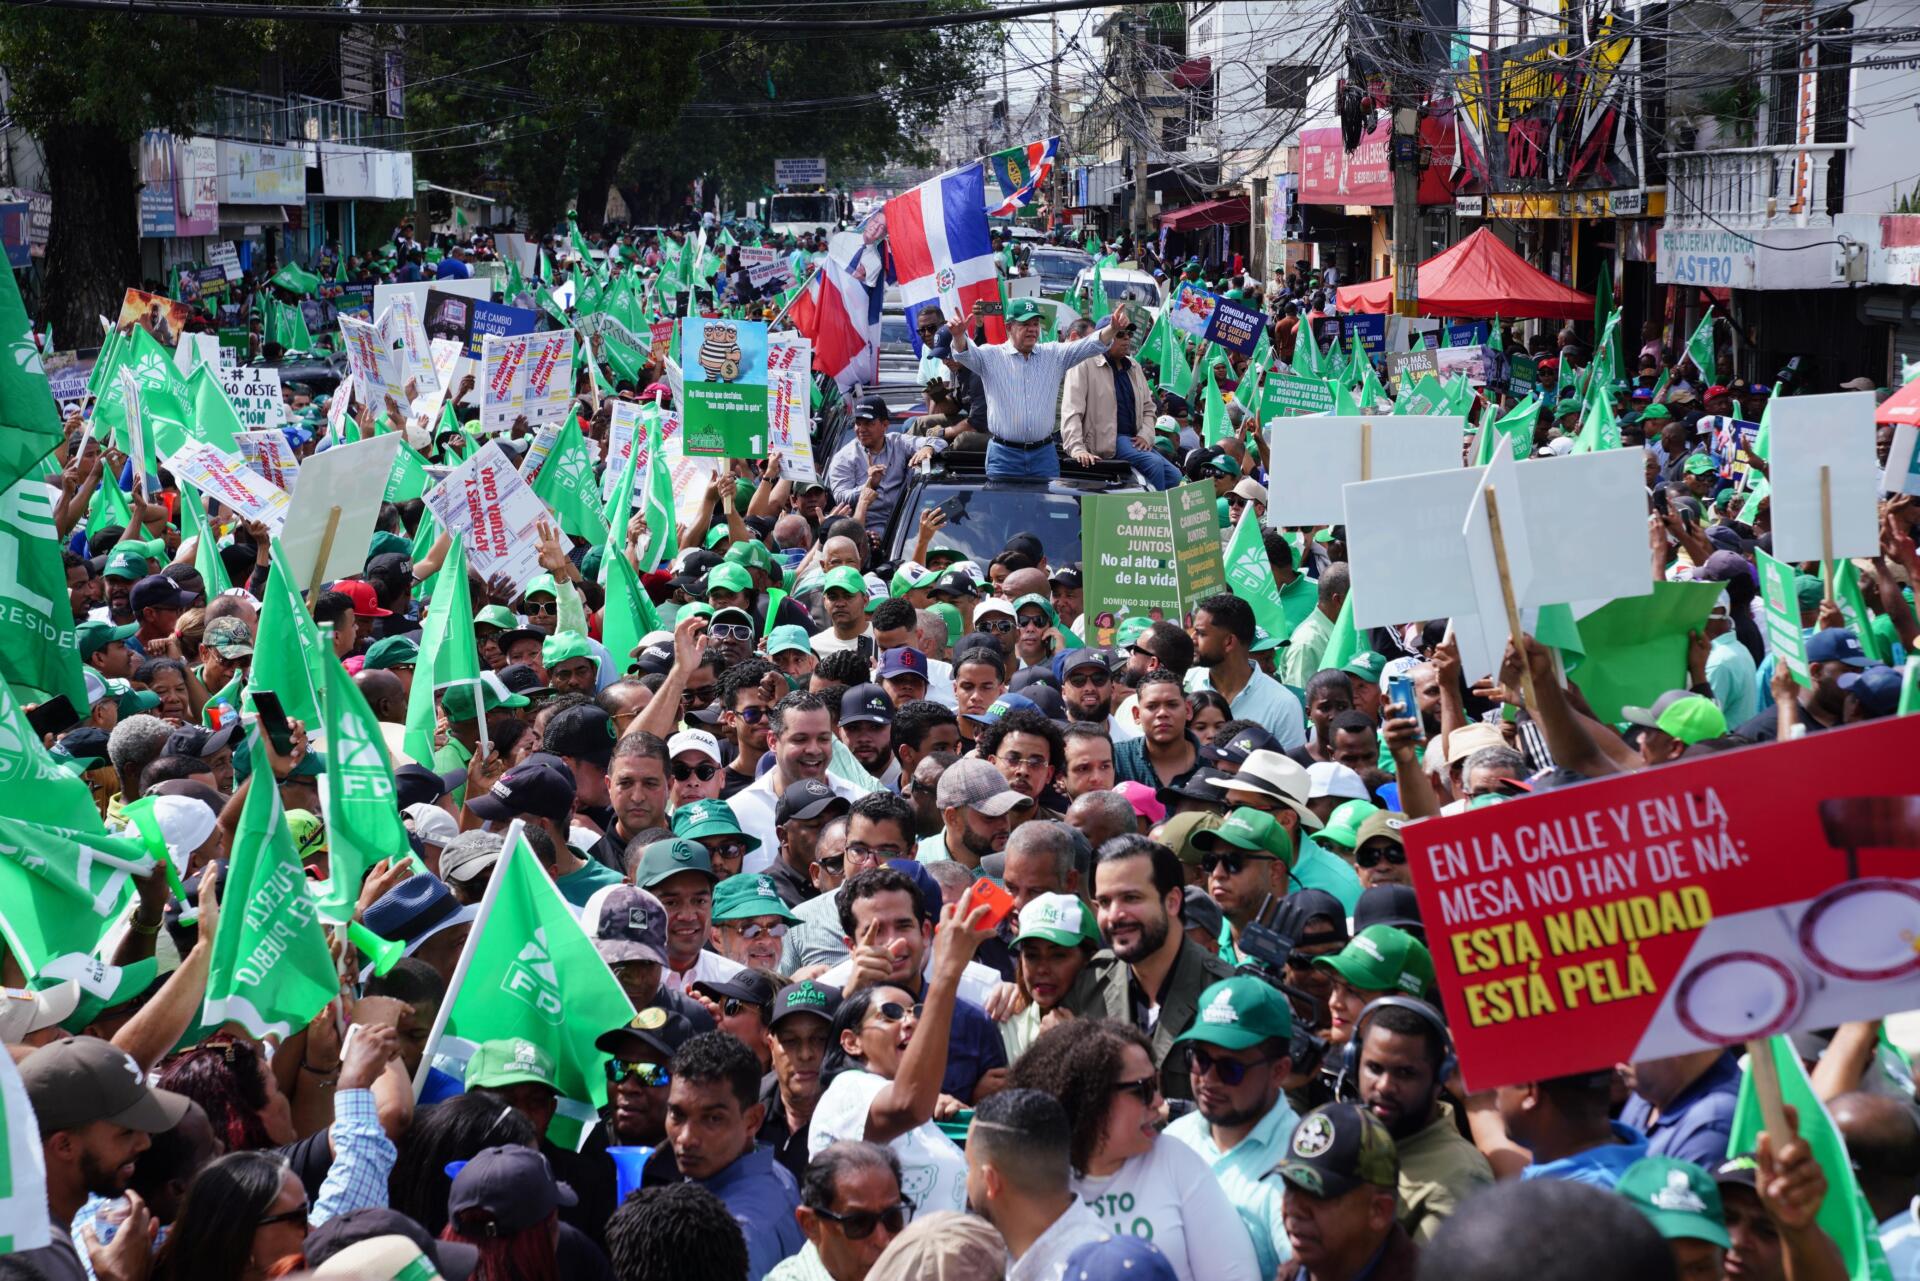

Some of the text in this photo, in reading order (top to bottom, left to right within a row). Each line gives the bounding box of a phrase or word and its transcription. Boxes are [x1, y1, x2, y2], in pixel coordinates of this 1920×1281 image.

[1676, 255, 1731, 284] ASTRO
[474, 308, 512, 326] QUÉ CAMBIO
[1220, 304, 1258, 326] COMIDA POR
[1220, 314, 1252, 332] LAS NUBES
[474, 321, 486, 331] TAN
[1220, 323, 1226, 331] EL
[1228, 326, 1251, 340] SUELDO
[1217, 330, 1243, 346] NO SUBE
[530, 344, 552, 385] APAGONES
[535, 337, 565, 396] FACTURA CARA
[780, 346, 798, 370] CARA
[1397, 354, 1427, 366] NO MÁS
[490, 349, 514, 390] APAGONES
[496, 342, 527, 401] FACTURA CARA
[224, 383, 277, 396] GO OESTE
[257, 398, 272, 410] LA
[774, 384, 784, 431] APAGONES
[239, 409, 266, 424] CIÓN
[782, 405, 790, 444] FACTURA
[749, 434, 762, 454] 1
[554, 470, 576, 488] FP
[580, 489, 595, 509] DEL
[465, 479, 490, 552] APAGONES Y
[481, 467, 508, 558] FACTURA CARA
[1116, 524, 1172, 538] CAMINEM
[1128, 540, 1172, 552] JUNTOS
[1101, 553, 1118, 566] No
[1120, 554, 1132, 568] al
[1134, 555, 1159, 568] alto
[1116, 572, 1178, 586] de la vida
[1231, 568, 1260, 588] FP
[1103, 597, 1138, 606] DOMINGO
[1150, 600, 1160, 608] DE
[1160, 600, 1180, 608] ESTE
[0, 604, 80, 650] RESIDE
[342, 776, 393, 798] FP
[1428, 786, 1729, 883] EN LA CALLE Y EN LA
[1438, 822, 1750, 926] MESA NO HAY DE NÁ:
[1450, 886, 1714, 975] ESTA NAVIDAD
[510, 969, 562, 1014] FP
[1462, 940, 1656, 1029] ESTÁ PELÁ
[787, 990, 826, 1002] OMAR
